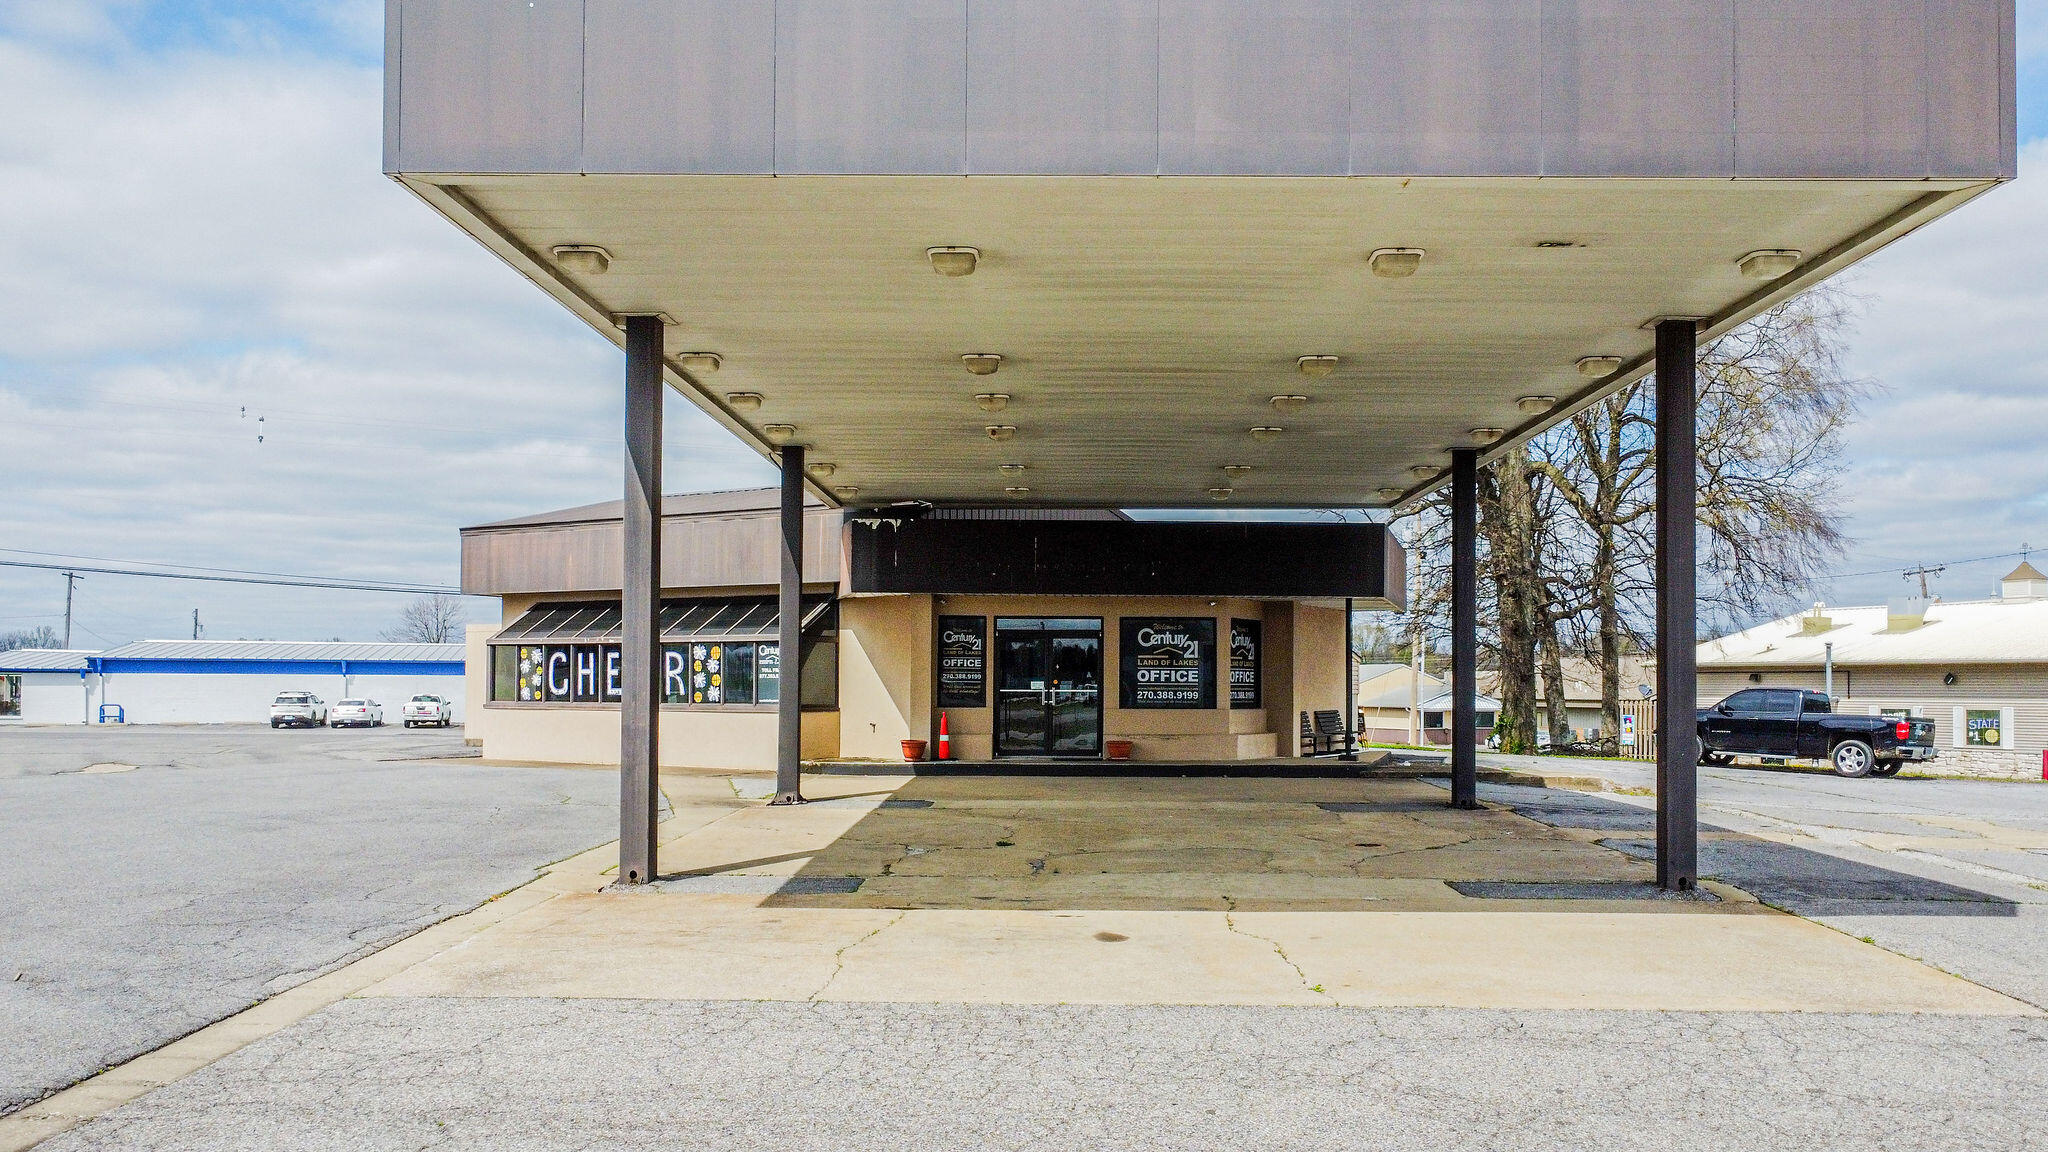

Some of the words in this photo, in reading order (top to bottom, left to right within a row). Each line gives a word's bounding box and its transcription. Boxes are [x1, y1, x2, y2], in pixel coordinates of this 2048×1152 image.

[944, 630, 975, 643] Century
[972, 639, 982, 650] 21
[1138, 628, 1189, 647] Century
[1184, 641, 1199, 658] 21
[1230, 629, 1251, 649] Century
[943, 659, 982, 667] OFFICE
[548, 651, 686, 696] CHER
[1137, 670, 1199, 682] OFFICE
[1230, 671, 1255, 683] OFFICE
[1137, 691, 1199, 699] 270.388.9199
[1968, 719, 2000, 730] STATE
